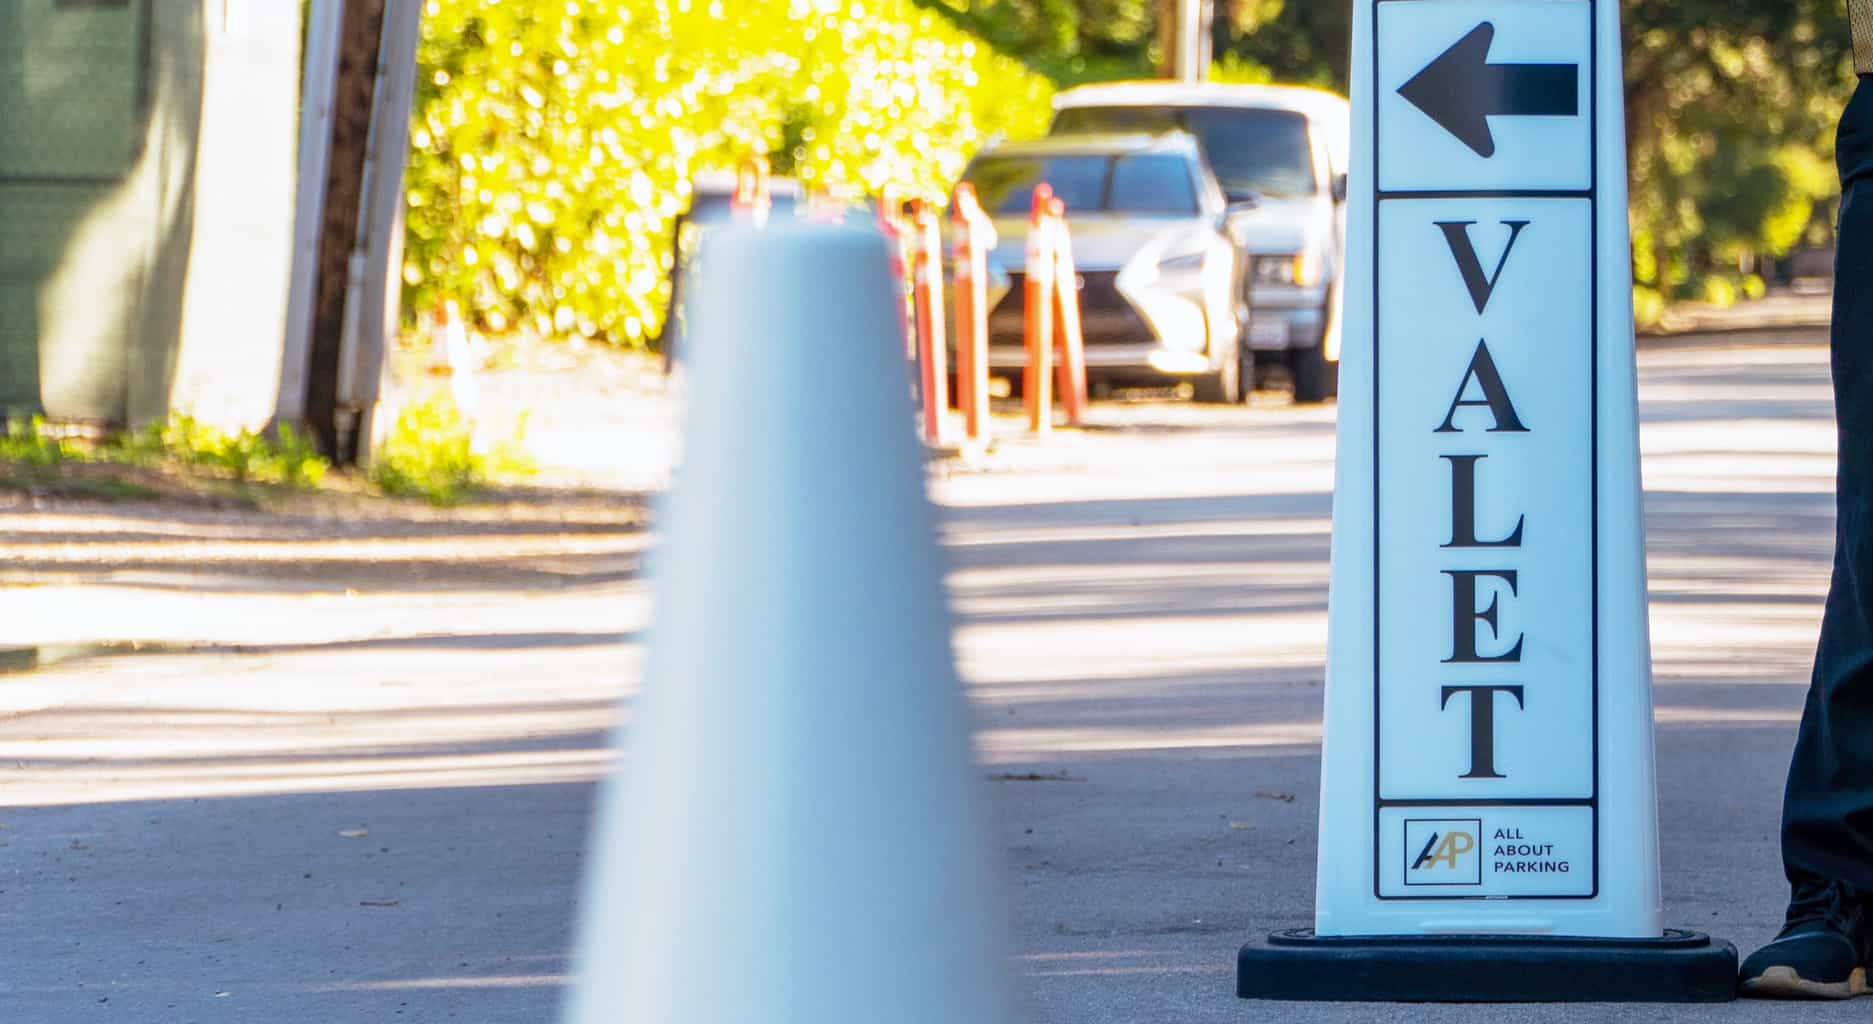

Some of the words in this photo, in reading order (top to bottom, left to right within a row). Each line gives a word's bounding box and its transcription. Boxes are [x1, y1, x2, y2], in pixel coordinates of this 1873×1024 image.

[1432, 220, 1531, 779] VALET
[1493, 828, 1524, 840] ALL
[1493, 844, 1554, 857] ABOUT
[1493, 861, 1570, 873] PARKING
